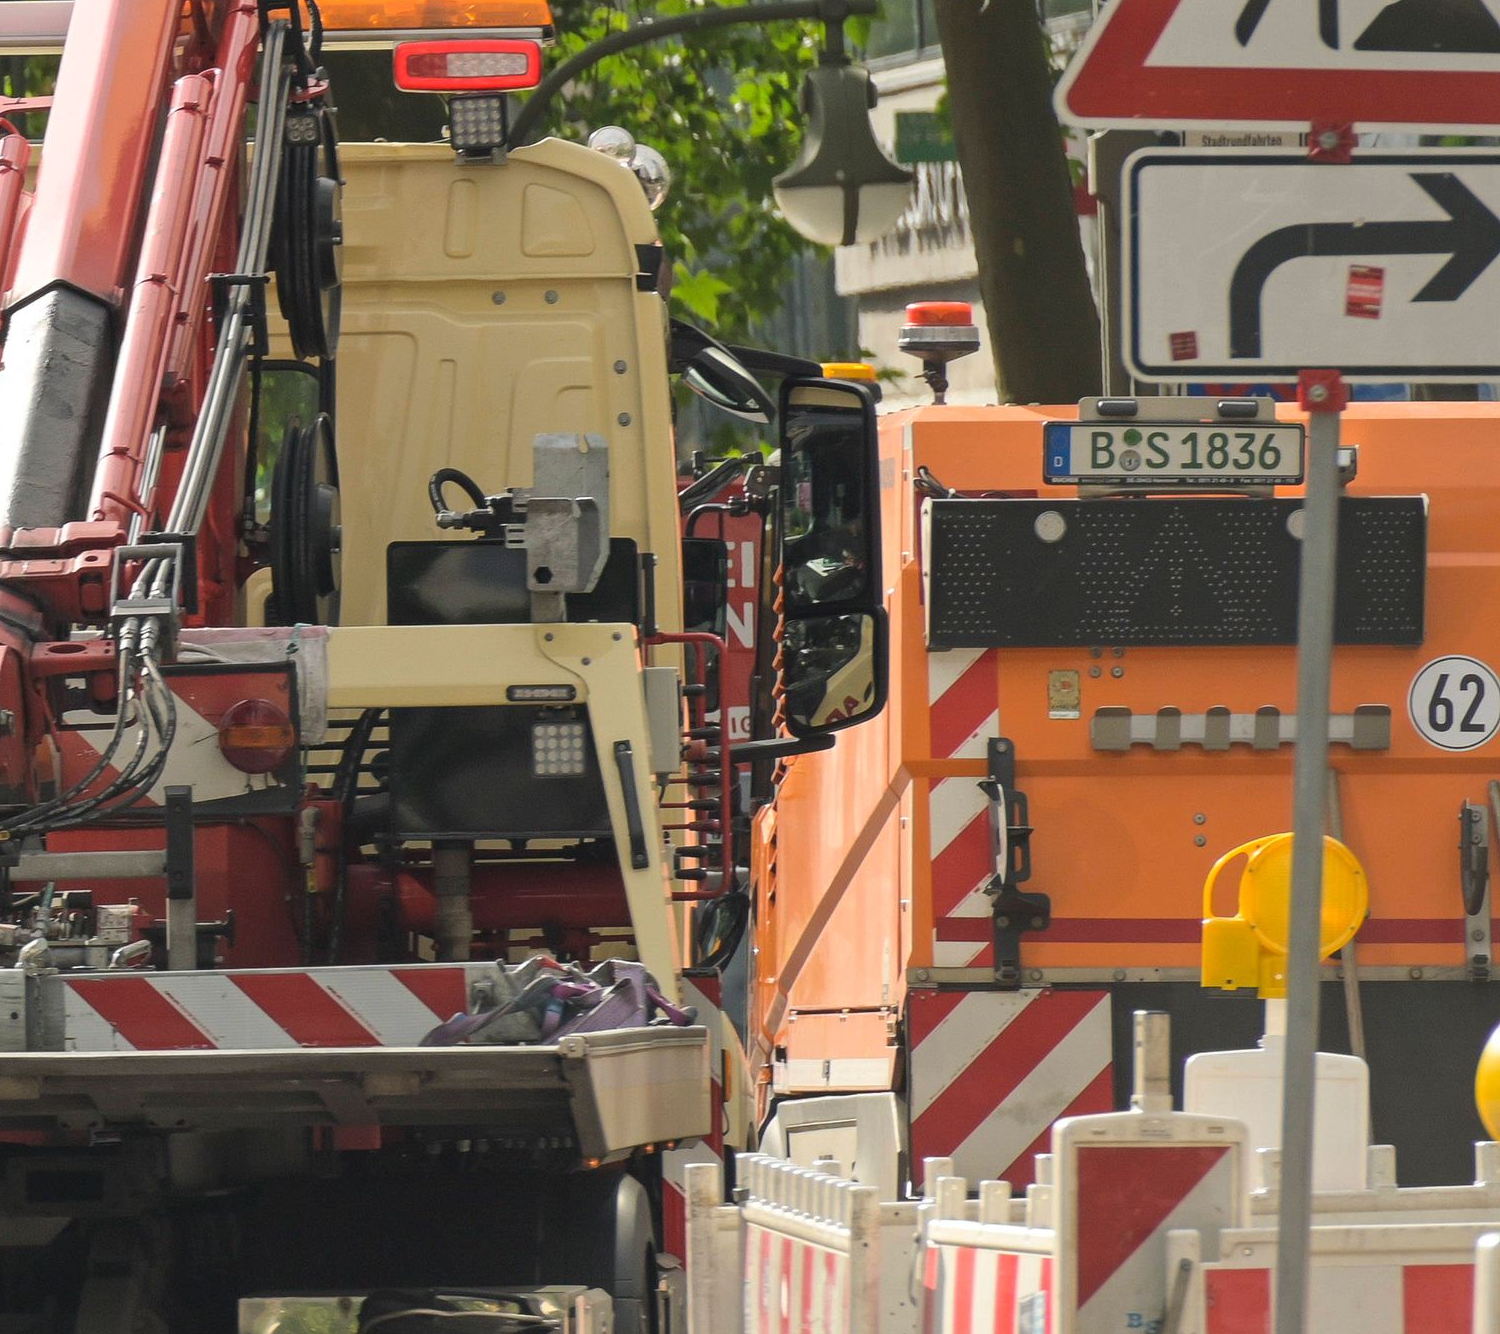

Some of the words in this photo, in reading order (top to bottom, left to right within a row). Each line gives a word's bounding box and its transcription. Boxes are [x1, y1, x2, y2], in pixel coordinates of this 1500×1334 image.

[1091, 431, 1115, 469] B
[1180, 432, 1282, 470] 1836
[1428, 673, 1485, 733] 62
